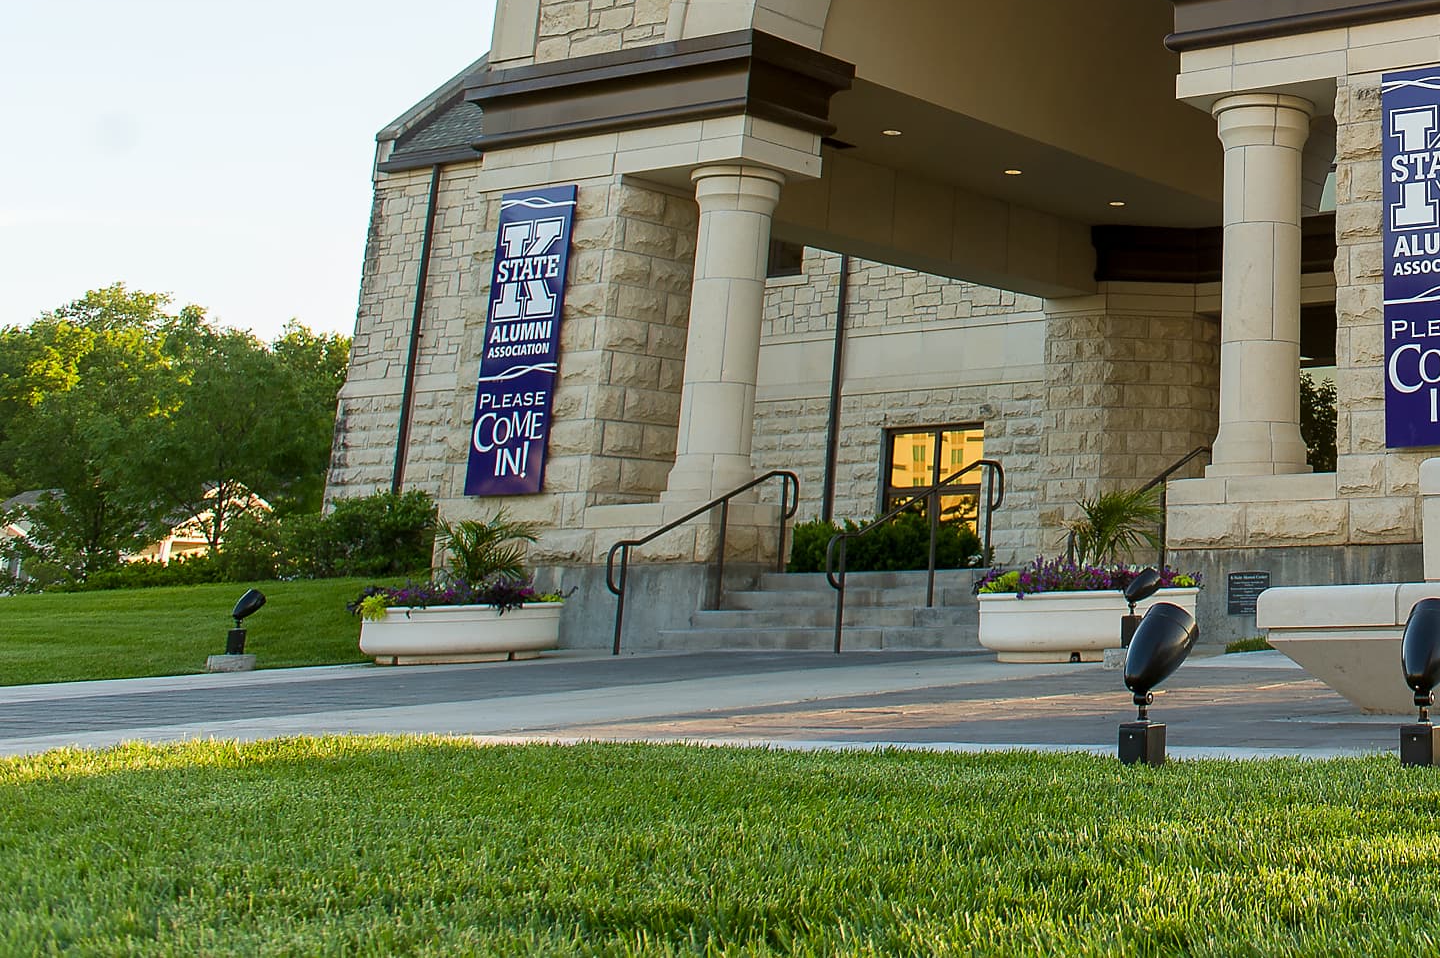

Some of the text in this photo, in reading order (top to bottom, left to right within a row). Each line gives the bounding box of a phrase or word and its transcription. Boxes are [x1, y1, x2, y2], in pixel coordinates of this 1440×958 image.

[491, 217, 565, 322] K STATE
[490, 321, 553, 343] ALUMNI
[488, 342, 550, 358] ASSOCIATION
[480, 391, 546, 409] PLEASE
[474, 410, 544, 452] COME
[495, 441, 529, 478] IN!
